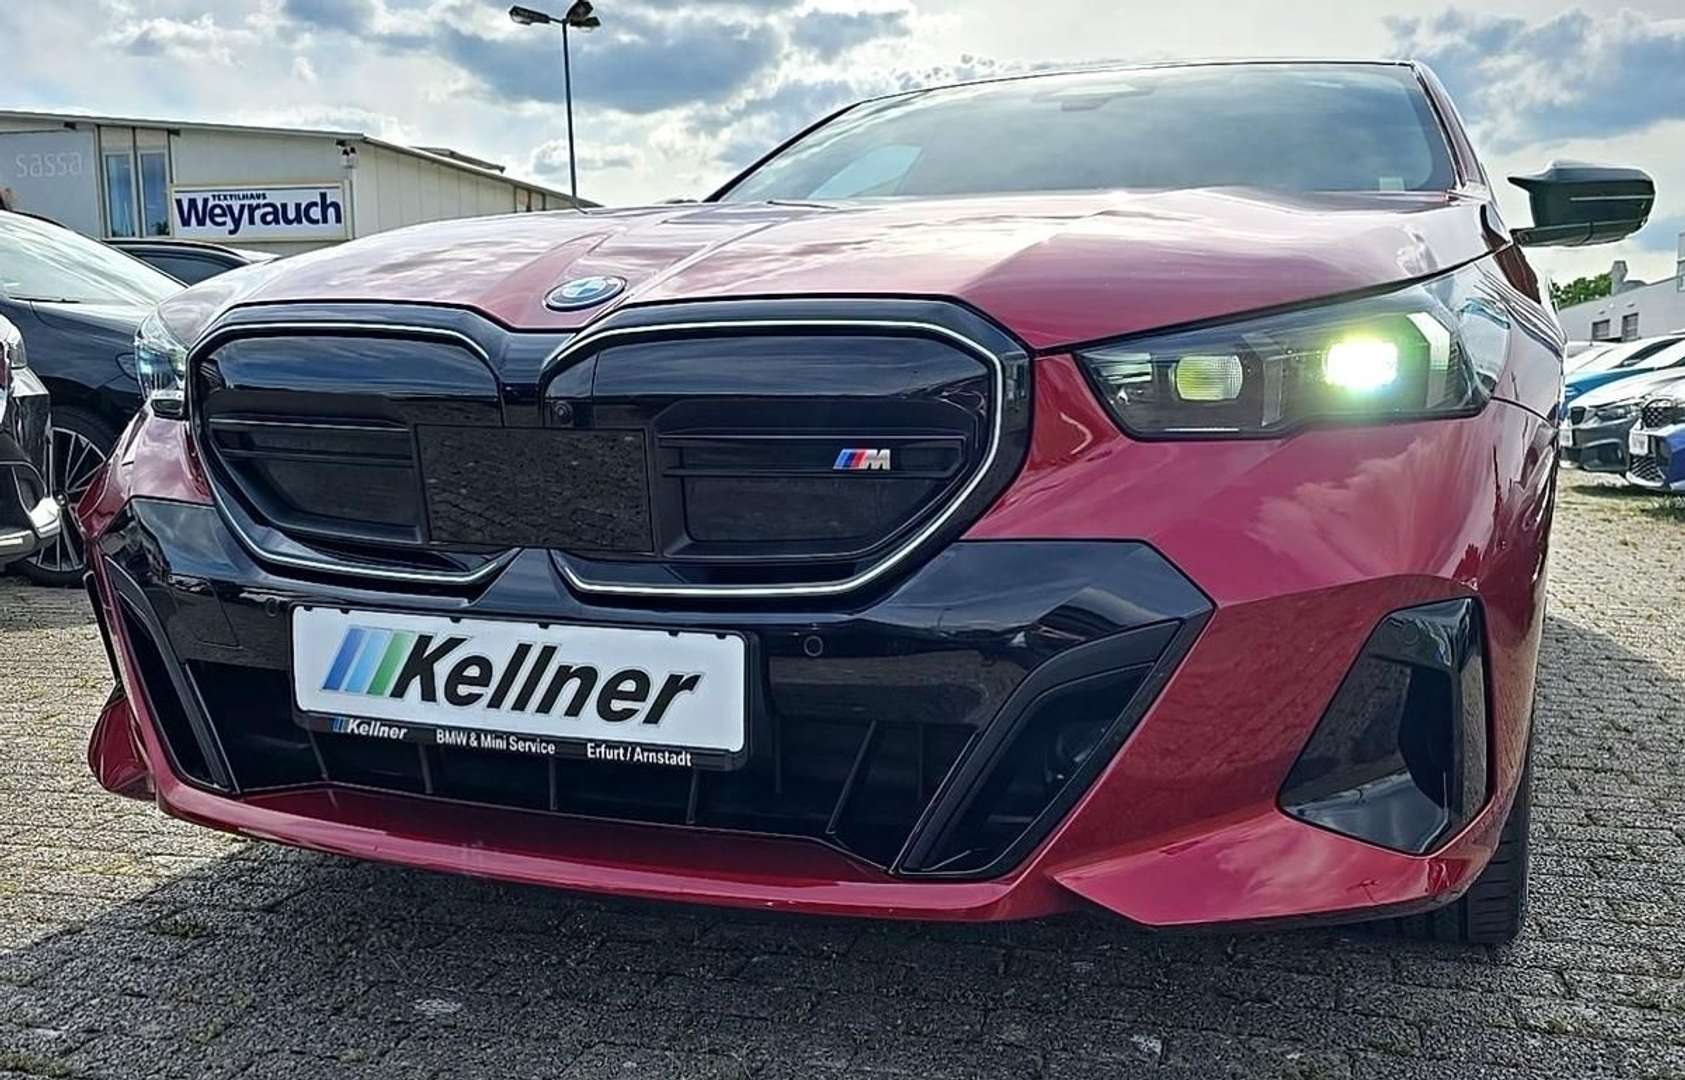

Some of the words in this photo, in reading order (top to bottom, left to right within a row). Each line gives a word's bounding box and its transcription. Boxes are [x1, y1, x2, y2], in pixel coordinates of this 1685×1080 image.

[15, 151, 83, 178] sassa
[211, 193, 267, 201] TEXTILHAUS
[175, 192, 342, 235] Weyrauch
[389, 633, 703, 725] Kellner
[347, 718, 408, 740] Kellner
[436, 729, 468, 746] BMW
[469, 732, 478, 747] &
[480, 734, 507, 750] Mini
[509, 736, 556, 754] Service
[587, 743, 625, 760] Erfurt
[633, 747, 692, 767] Arnstadt
